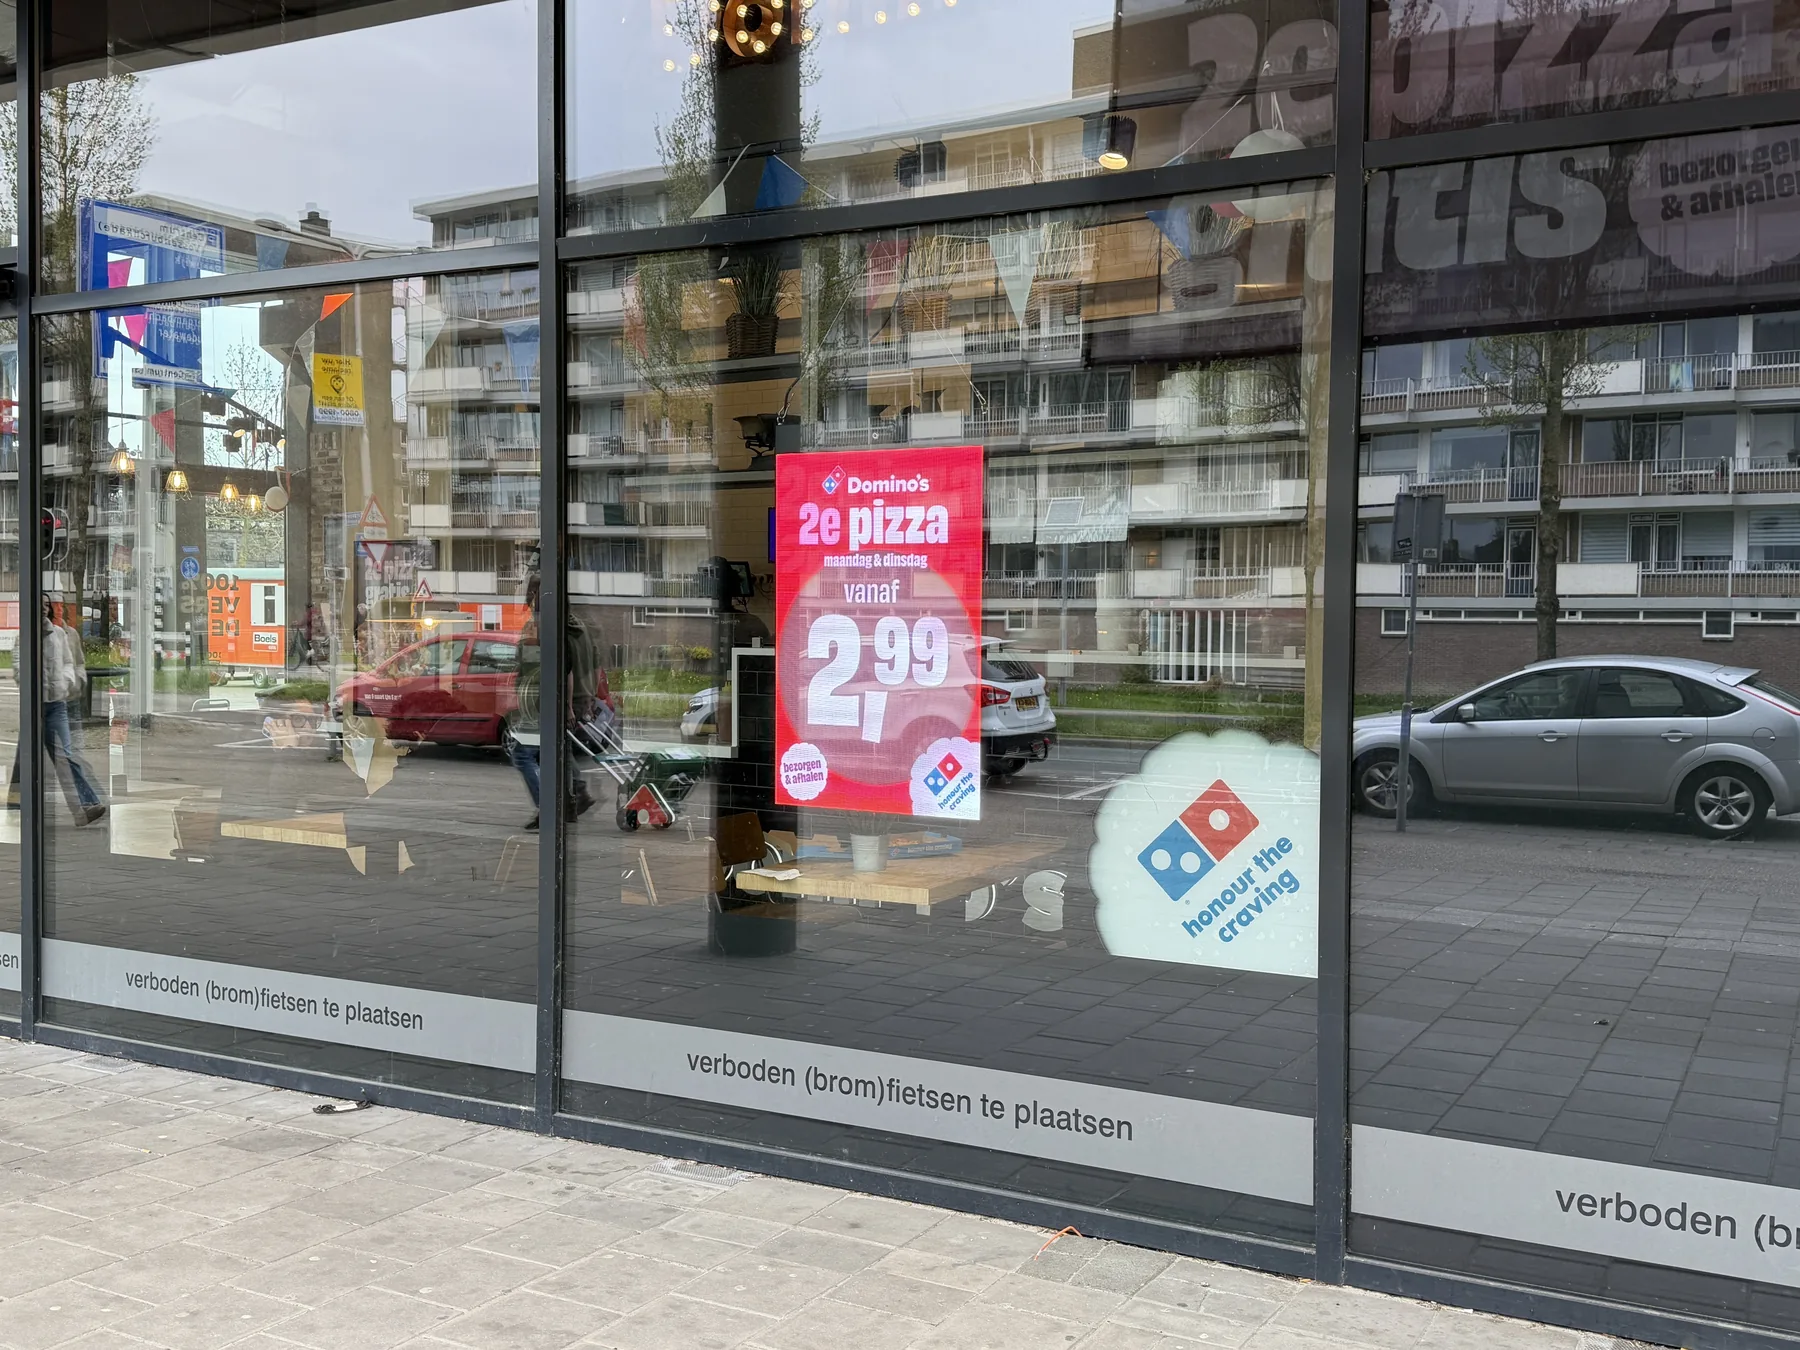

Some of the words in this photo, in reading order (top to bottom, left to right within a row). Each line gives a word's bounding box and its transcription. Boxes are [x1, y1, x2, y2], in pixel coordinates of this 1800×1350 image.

[1661, 194, 1683, 221] &
[1690, 170, 1800, 216] afhale
[847, 474, 930, 494] Domino's
[799, 502, 841, 545] 2e
[849, 499, 949, 551] pizza
[823, 554, 872, 569] maandag
[873, 554, 882, 567] &
[883, 553, 928, 568] dinsdag
[844, 579, 900, 604] vanaf
[254, 633, 277, 644] Boels
[783, 759, 822, 773] bezorgen
[785, 774, 792, 785] &
[792, 771, 824, 785] afhalen
[938, 783, 962, 810] honour
[960, 772, 974, 786] the
[949, 784, 975, 810] craving
[1181, 867, 1253, 939] honour
[1253, 836, 1293, 874] the
[1218, 868, 1301, 943] craving
[0, 953, 19, 969] en
[125, 969, 199, 998] verboden
[205, 979, 318, 1015] (brom)fietsen
[323, 996, 340, 1018] te
[345, 1000, 423, 1030] plaatsen
[686, 1051, 796, 1087] verboden
[804, 1064, 972, 1115] (brom)fietsen
[980, 1093, 1005, 1119] te
[1014, 1099, 1134, 1141] plaatsen
[1555, 1189, 1737, 1239] verboden
[1754, 1214, 1800, 1253] (b
